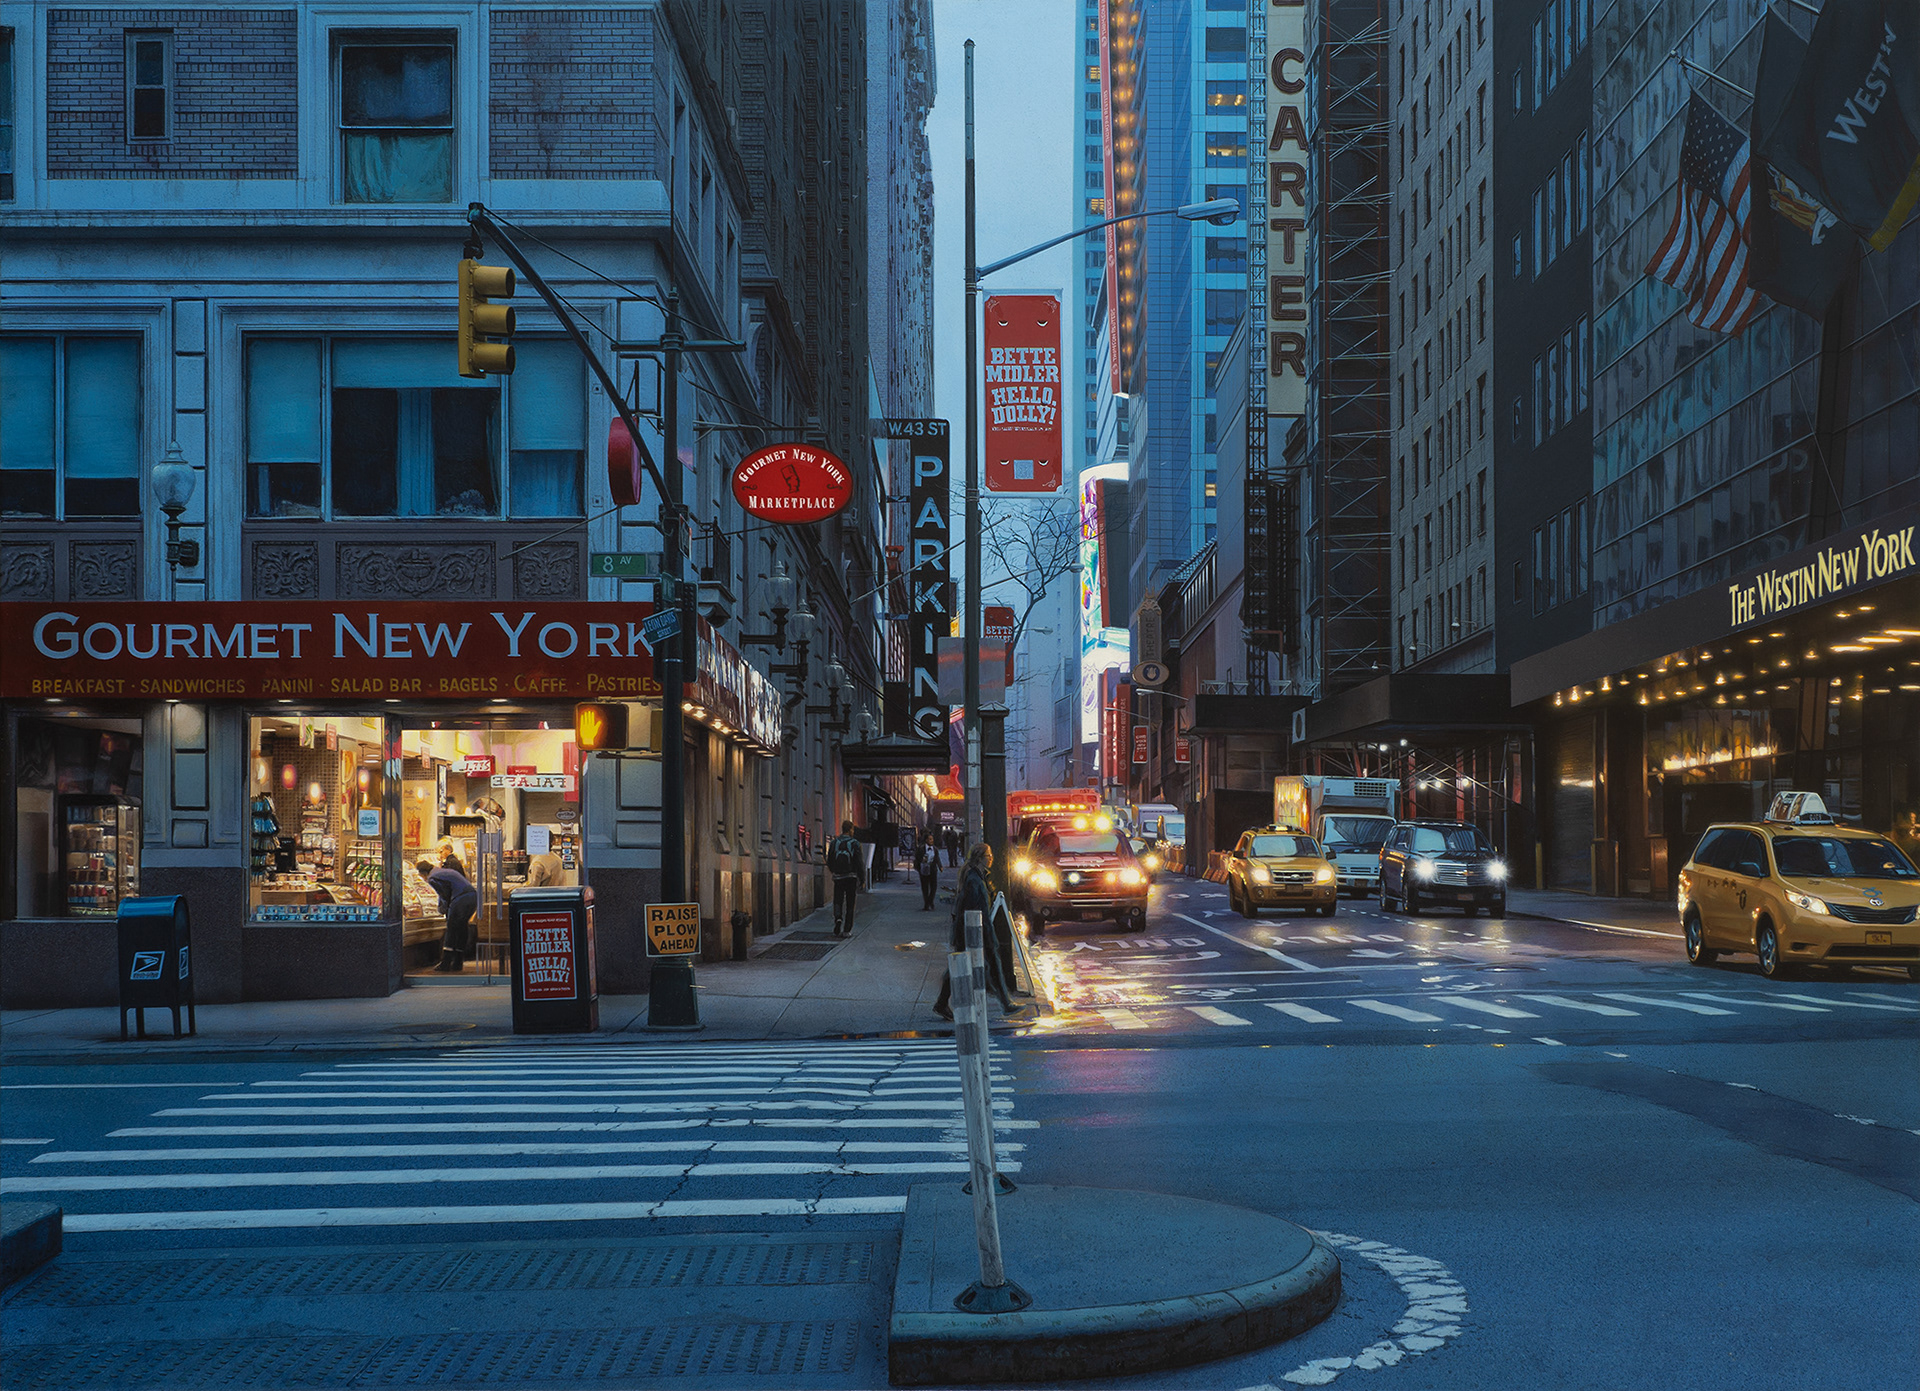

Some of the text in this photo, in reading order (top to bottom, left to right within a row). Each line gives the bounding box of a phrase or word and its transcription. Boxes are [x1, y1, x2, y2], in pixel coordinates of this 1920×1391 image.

[1268, 47, 1308, 378] CARTER
[990, 347, 1056, 365] BETTE
[985, 365, 1060, 383] MIDLER
[991, 405, 1057, 425] DOLLY!
[927, 421, 947, 436] ST
[738, 448, 845, 484] GOURMET NEW YORK
[748, 495, 836, 509] MARKETPLACE
[602, 555, 632, 573] 8 AV
[1728, 526, 1916, 626] THE WESTIN NEW YORK
[914, 456, 947, 739] PARKING
[32, 611, 655, 660] GOURMET NEW YORK
[31, 678, 125, 694] BREAKFAST
[140, 678, 246, 694] SANDWICHES
[262, 678, 313, 693] PANINI
[330, 677, 383, 693] SALAD
[389, 677, 422, 693] BAR
[439, 676, 498, 693] BAGELS
[586, 673, 663, 692] PASTRIES
[651, 907, 697, 921] RAISE
[525, 928, 569, 943] BETTE
[654, 923, 697, 937] PLOW
[524, 941, 572, 955] MIDLER
[660, 938, 695, 951] AHEAD
[527, 970, 570, 984] DOLLY!
